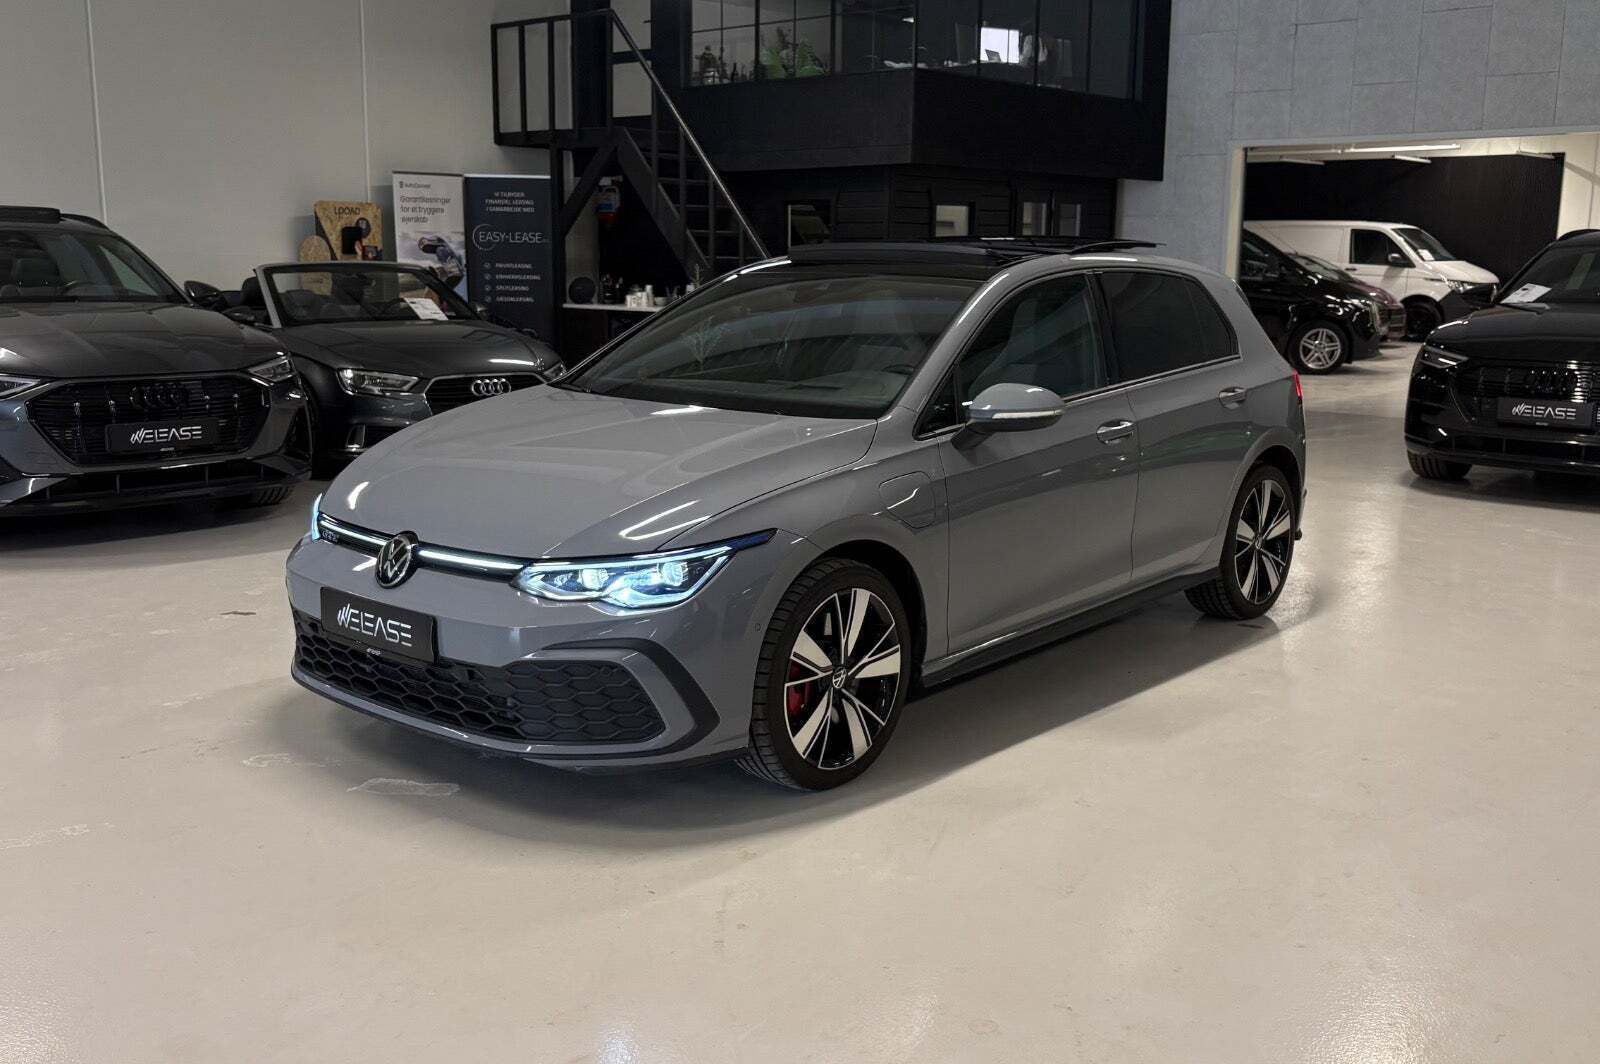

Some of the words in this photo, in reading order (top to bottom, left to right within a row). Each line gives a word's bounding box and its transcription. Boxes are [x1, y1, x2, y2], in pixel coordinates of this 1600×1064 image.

[479, 231, 543, 244] EASY-LEASE
[1512, 402, 1576, 420] WELEASE
[130, 425, 202, 444] WELEASE
[337, 603, 412, 647] WELEASE
